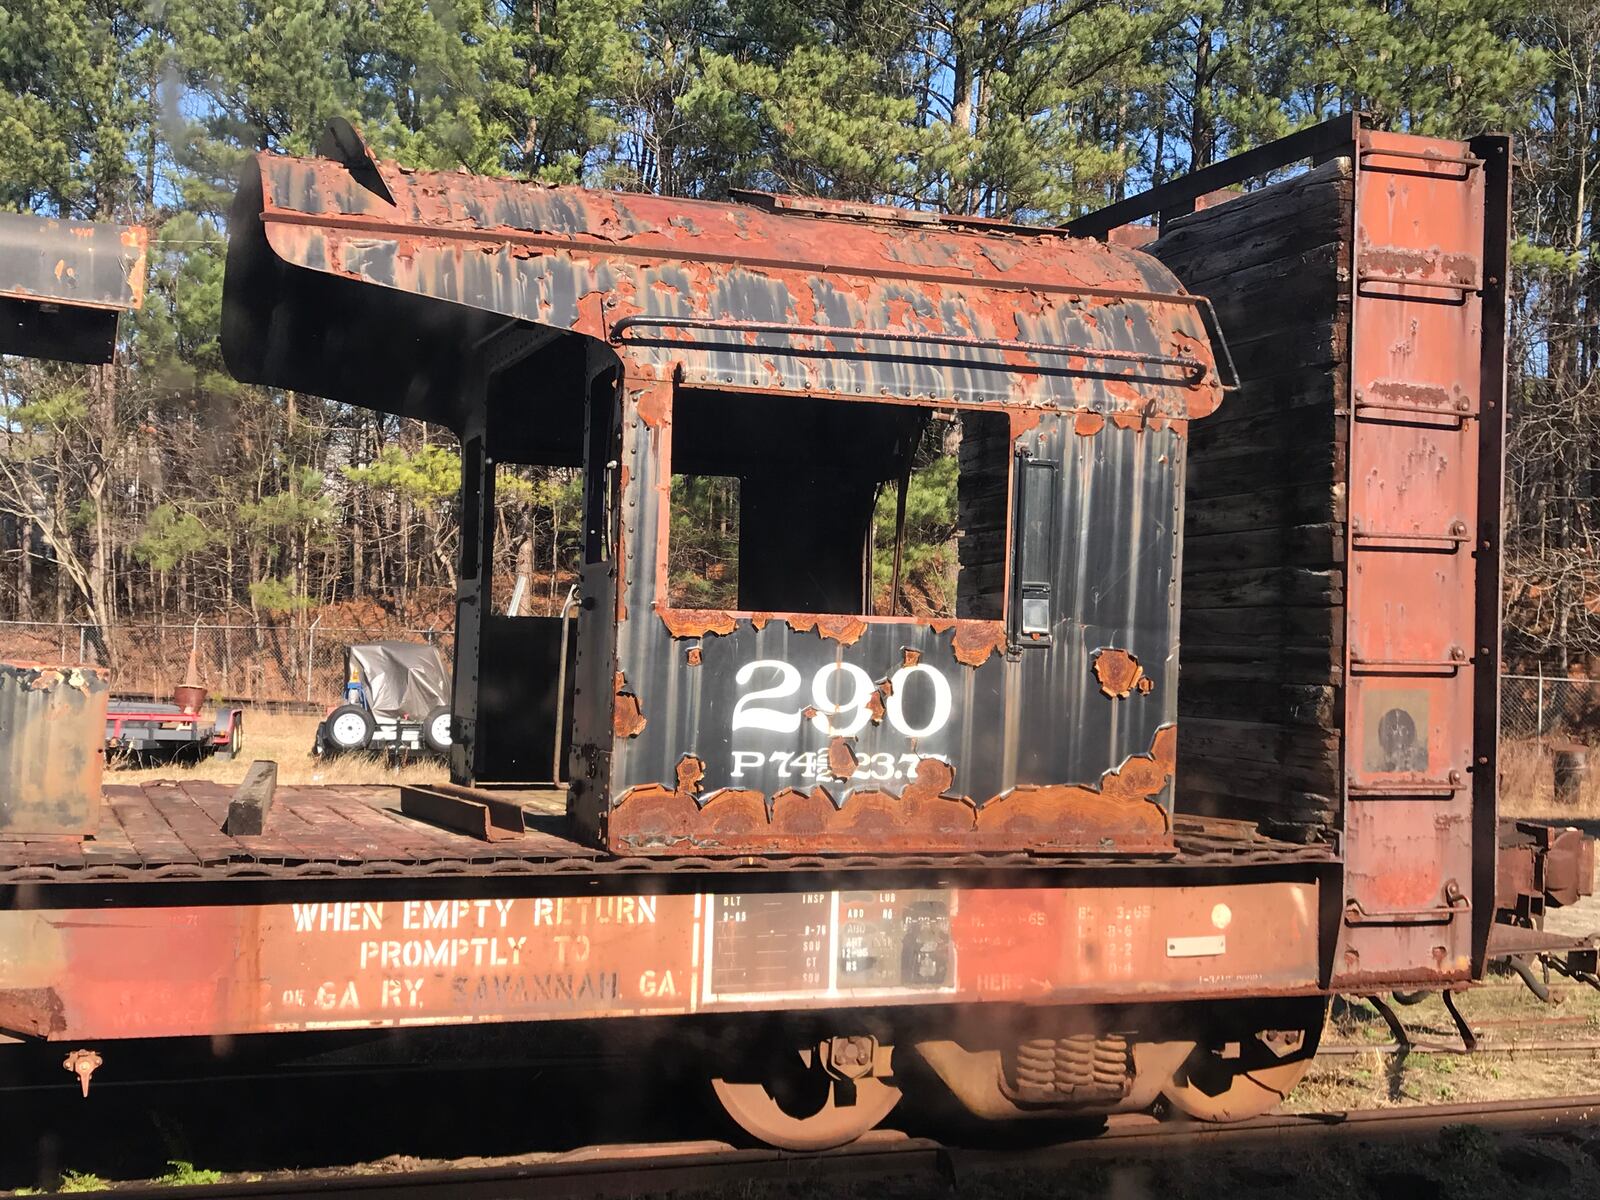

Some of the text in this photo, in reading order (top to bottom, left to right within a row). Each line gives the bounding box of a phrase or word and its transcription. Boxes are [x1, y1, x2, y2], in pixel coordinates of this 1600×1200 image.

[732, 660, 952, 737] 290
[292, 895, 657, 932] WHEN EMPTY RETURN
[723, 896, 741, 906] BLT
[802, 894, 825, 904] INSP
[360, 935, 590, 970] PROMPTLY TO
